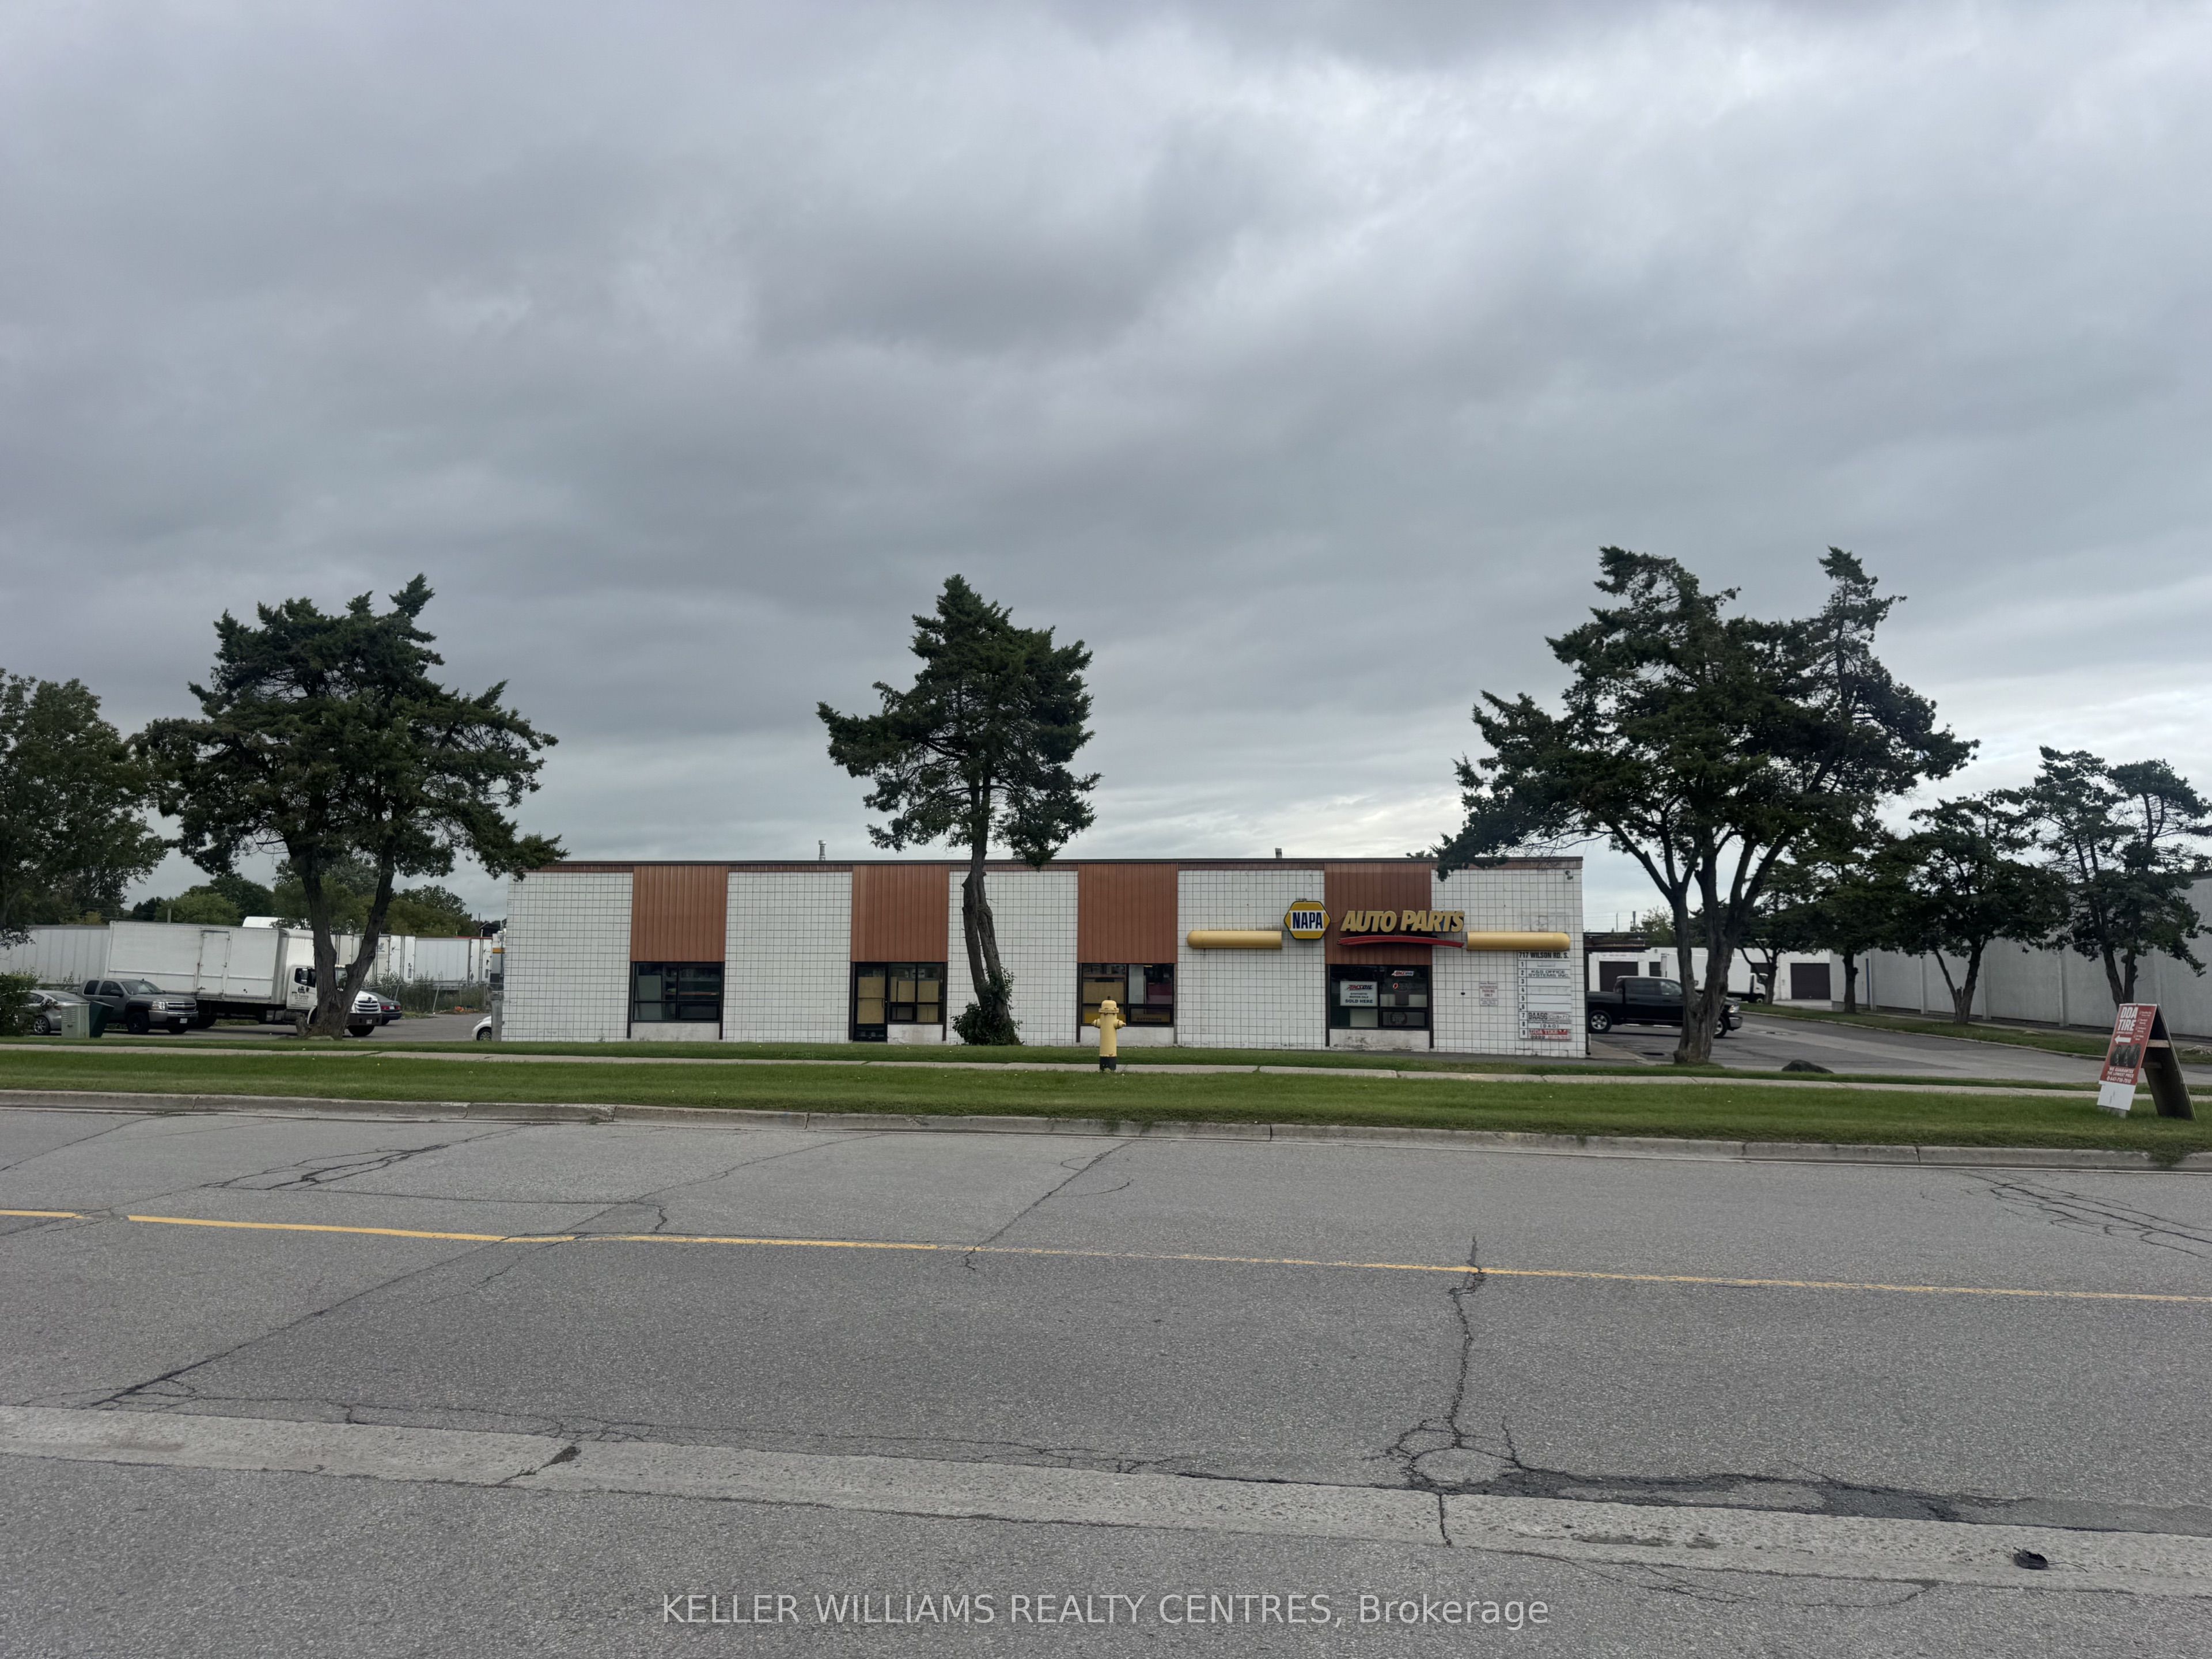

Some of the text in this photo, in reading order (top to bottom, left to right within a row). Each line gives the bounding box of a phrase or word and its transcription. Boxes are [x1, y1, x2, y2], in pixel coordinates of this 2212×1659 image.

[1293, 912, 1323, 929] NAPA
[1340, 910, 1465, 933] AUTO PARTS
[2120, 1007, 2138, 1018] DDA
[2118, 1020, 2137, 1031] TIRE
